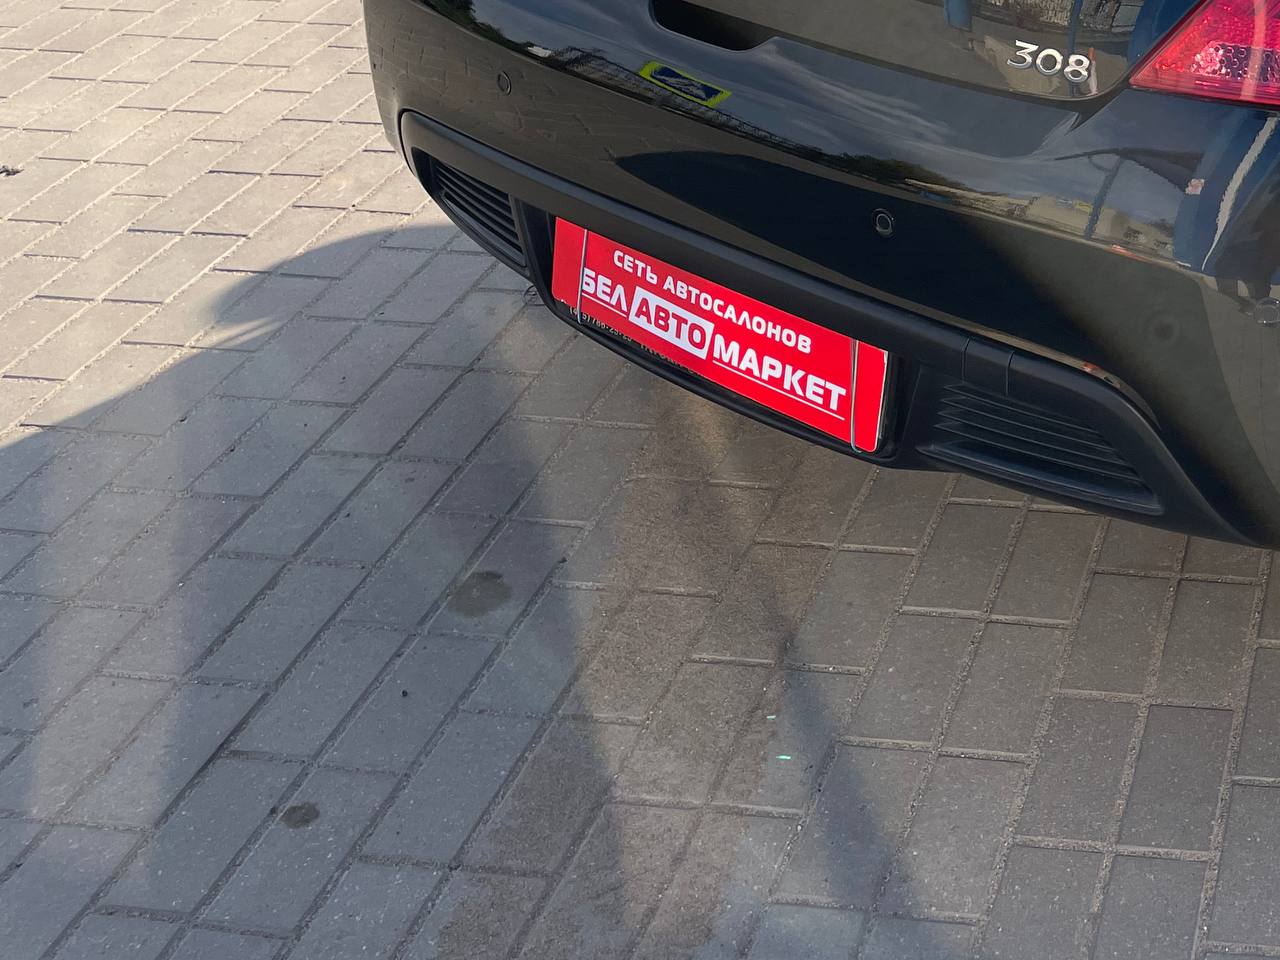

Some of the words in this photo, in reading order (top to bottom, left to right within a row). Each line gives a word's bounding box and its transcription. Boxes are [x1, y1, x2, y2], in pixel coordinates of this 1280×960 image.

[1006, 39, 1092, 84] 308
[613, 249, 659, 284] СЕТЬ
[662, 276, 812, 354] АВТОСАЛОНОВ
